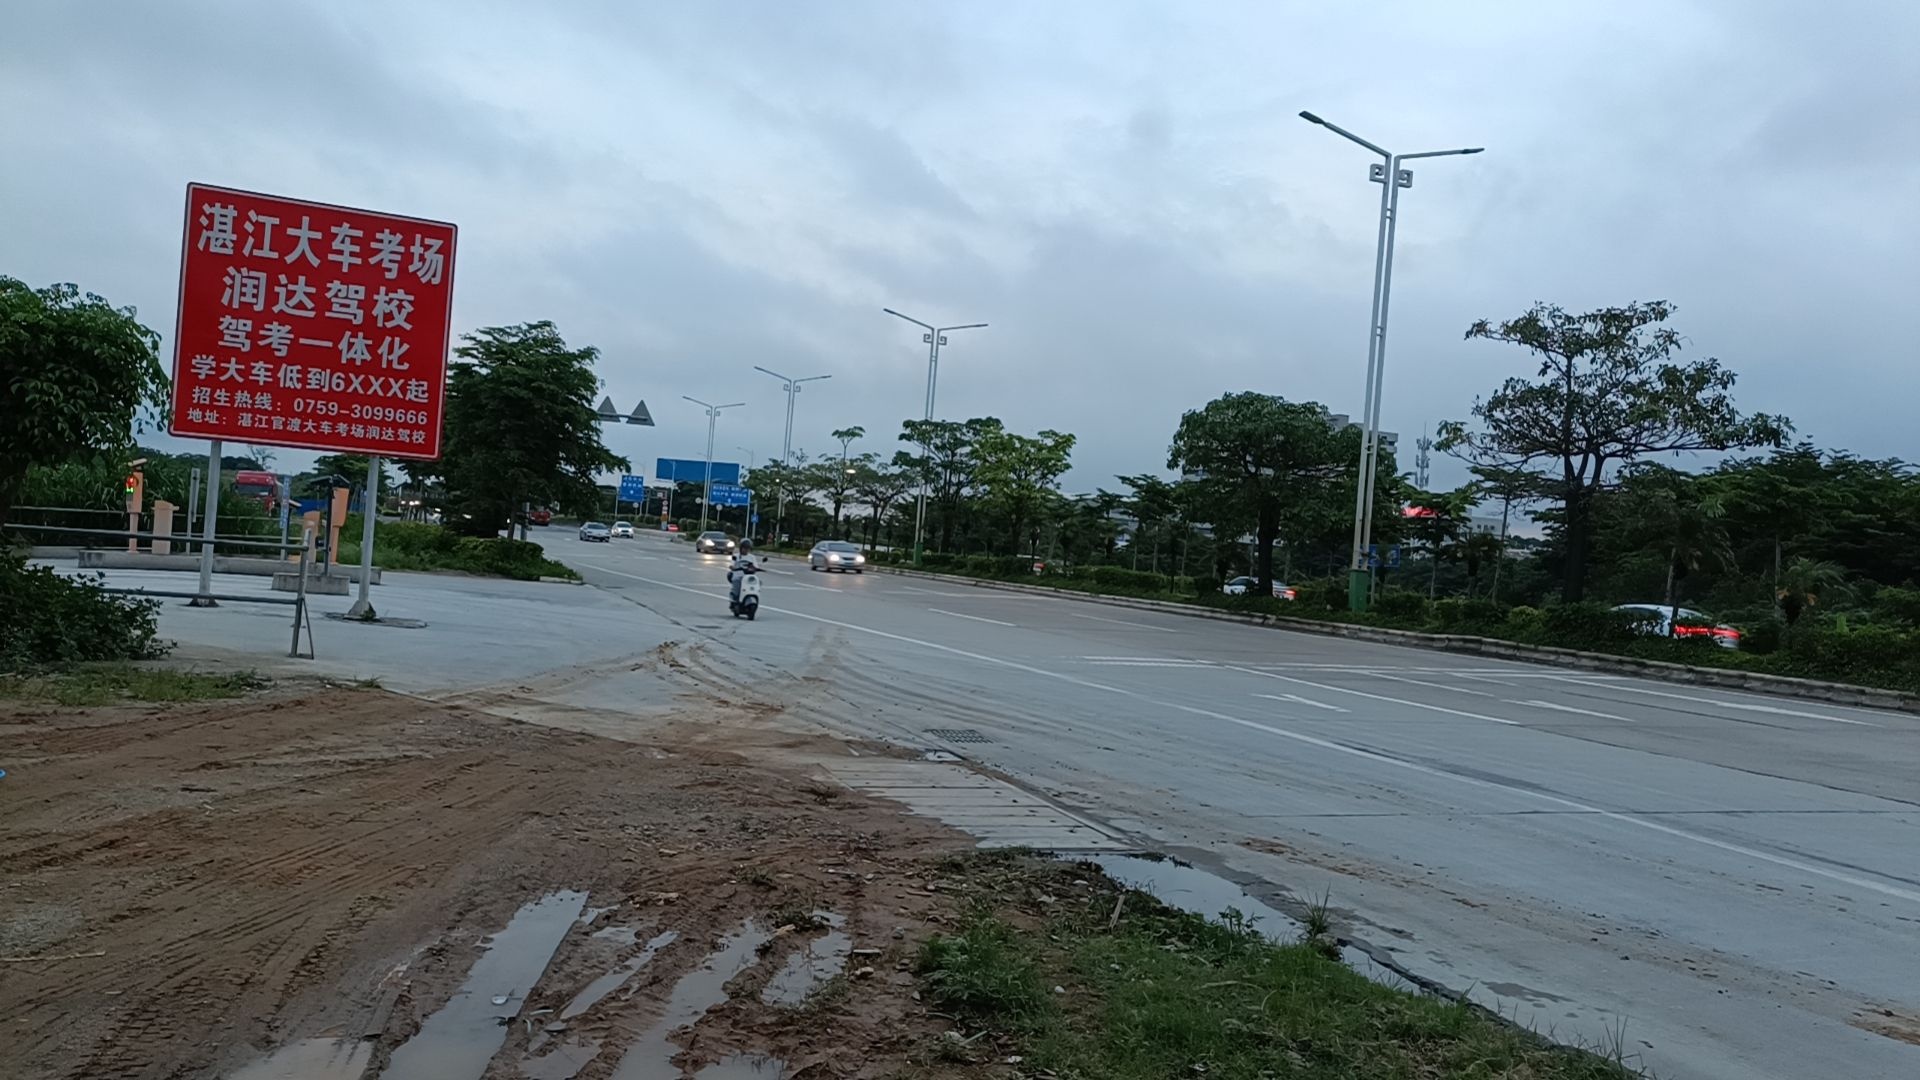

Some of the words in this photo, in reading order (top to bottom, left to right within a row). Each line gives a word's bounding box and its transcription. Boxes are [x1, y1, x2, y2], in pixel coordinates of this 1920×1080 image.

[197, 202, 445, 286] 湛江大车考场
[220, 265, 416, 331] 润达驾校
[217, 315, 411, 371] 驾考一体化
[190, 354, 430, 404] 学大车低到6XXX起
[237, 413, 427, 445] 湛江官渡大车考场润达驾校
[293, 397, 429, 426] 0759-3099666
